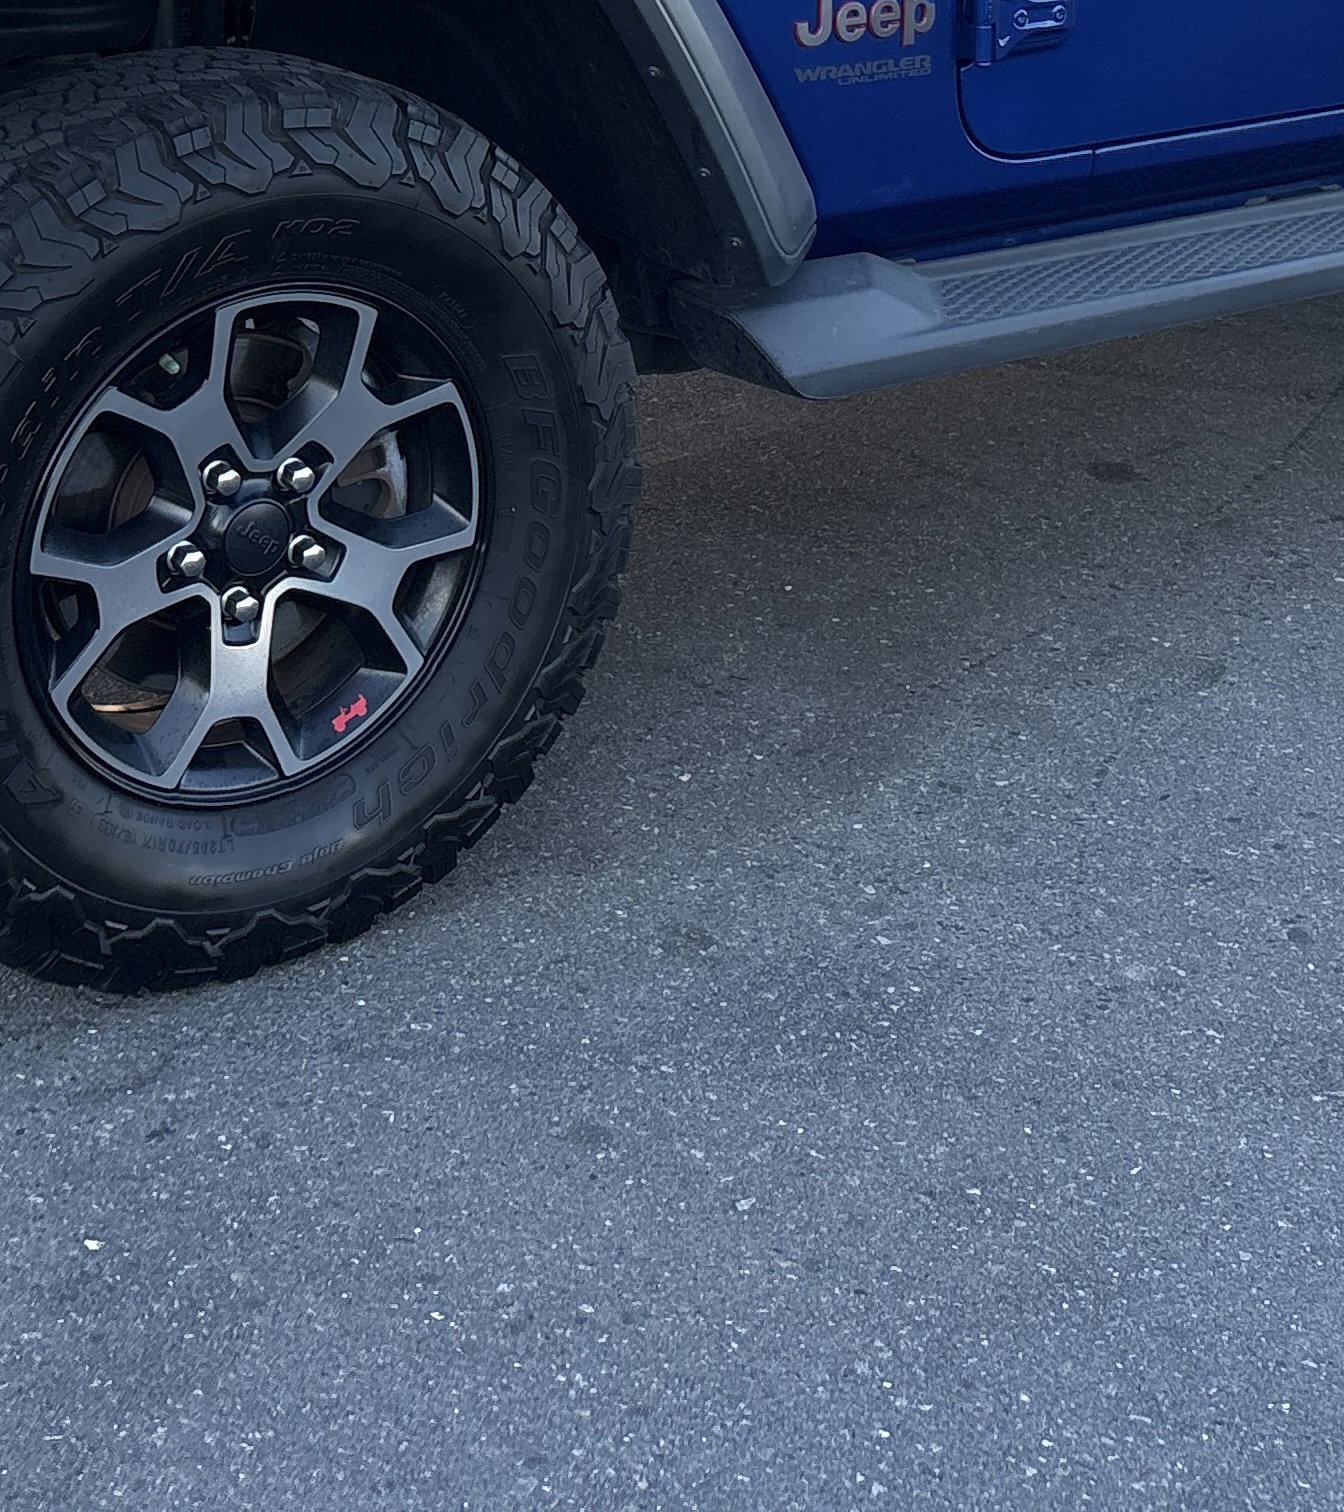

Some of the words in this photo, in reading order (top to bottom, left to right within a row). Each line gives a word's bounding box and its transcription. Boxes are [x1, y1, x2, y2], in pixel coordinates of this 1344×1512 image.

[793, 54, 932, 84] WRANGLER
[837, 67, 932, 87] UNLIMITED
[235, 520, 280, 557] Jeep
[352, 352, 563, 832] BFGoodrich
[187, 859, 295, 889] Champion
